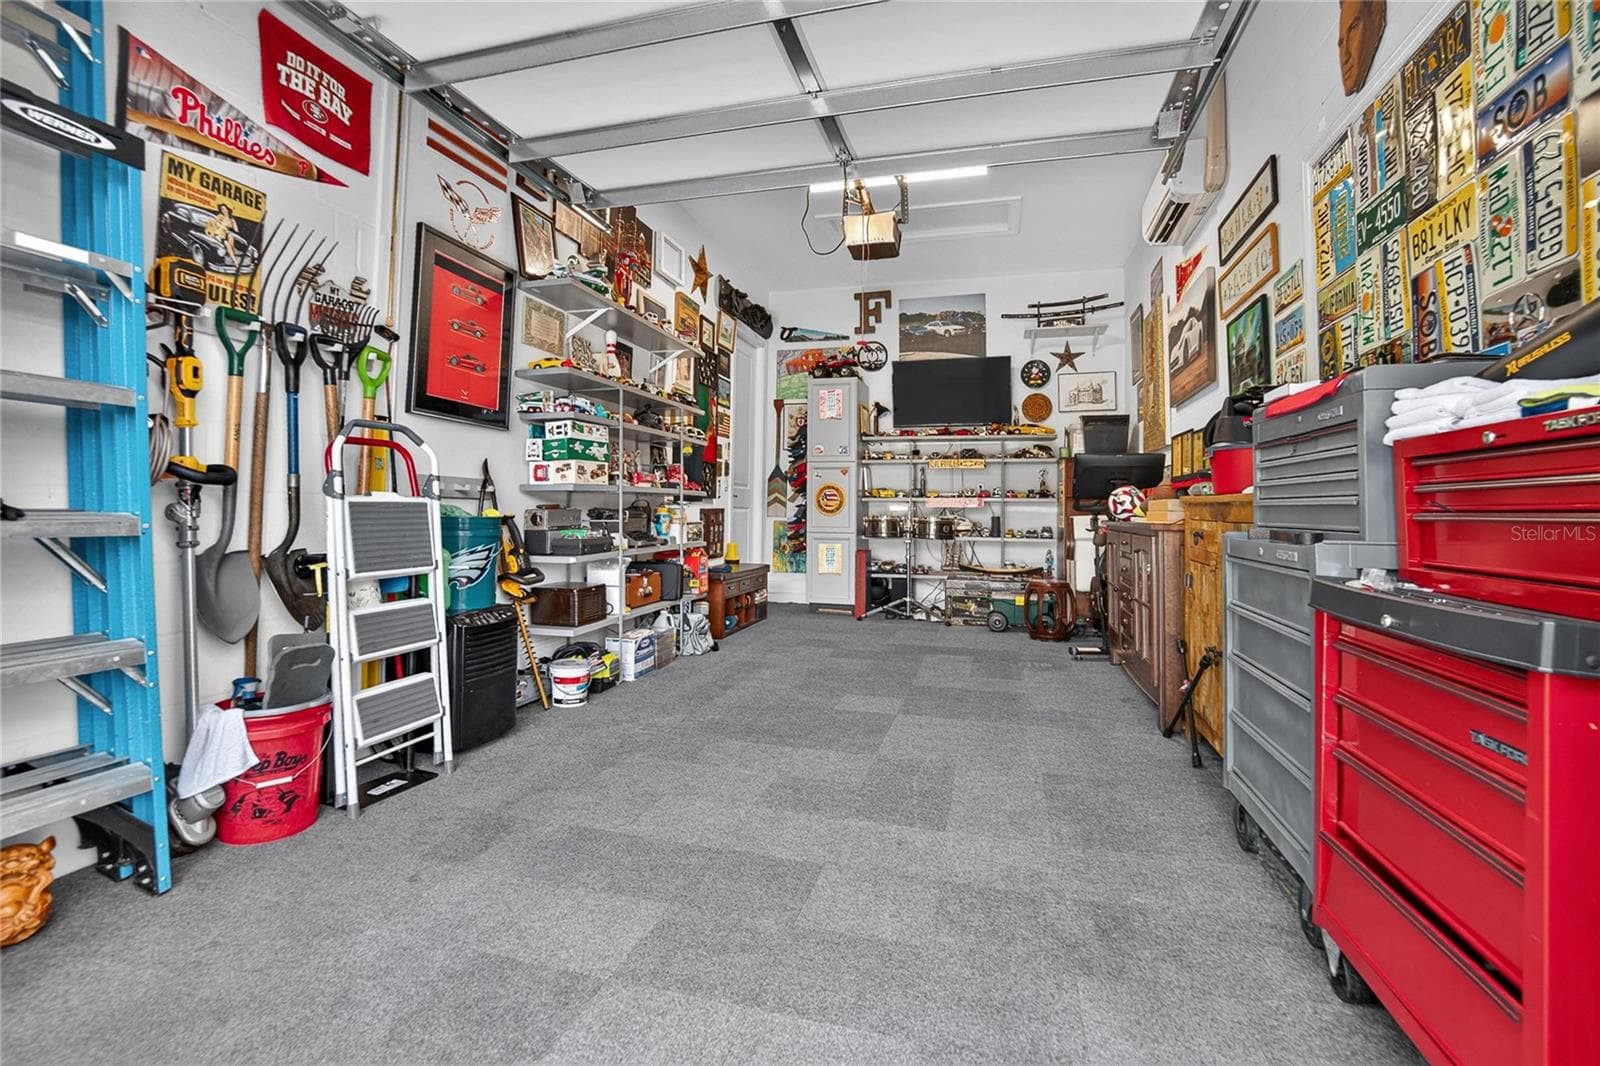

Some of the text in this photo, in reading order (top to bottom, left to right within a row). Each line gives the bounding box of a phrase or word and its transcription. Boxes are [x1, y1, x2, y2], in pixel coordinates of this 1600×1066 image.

[277, 63, 316, 100] THE
[319, 84, 353, 127] BAY
[287, 50, 346, 101] DO IT FOR
[27, 107, 97, 143] WERNER
[171, 85, 275, 168] Phillies
[1490, 74, 1547, 139] SOB
[168, 157, 195, 183] MY
[199, 172, 262, 211] GARAGE
[1409, 157, 1429, 213] 480
[853, 289, 892, 335] F
[1419, 290, 1437, 358] SOB
[1542, 415, 1575, 431] TASK
[1470, 731, 1498, 752] TASK
